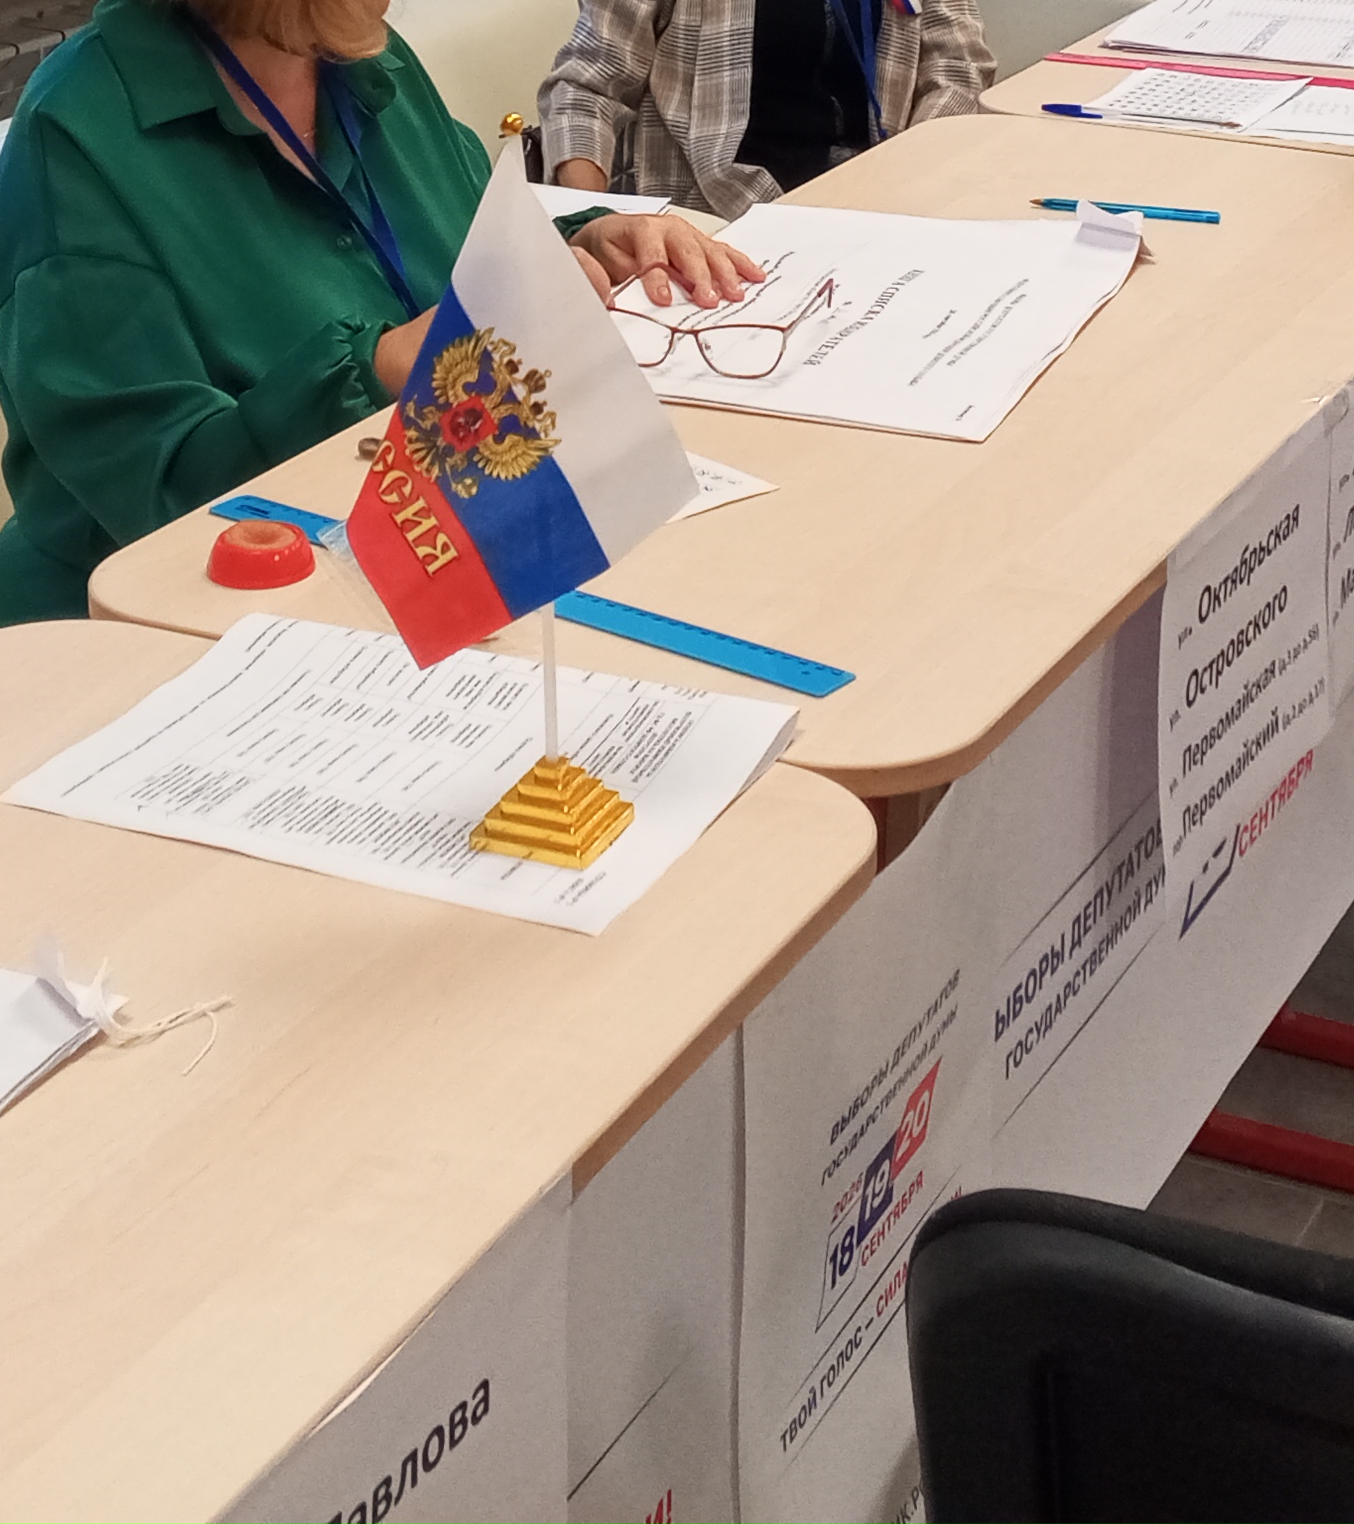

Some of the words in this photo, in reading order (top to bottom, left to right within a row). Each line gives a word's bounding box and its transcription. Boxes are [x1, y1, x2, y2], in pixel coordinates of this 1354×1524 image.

[372, 440, 460, 578] ССИЯ
[1198, 503, 1300, 624] Октябрьская
[1186, 585, 1288, 708] Островского
[1182, 707, 1280, 838] Первомайский
[1183, 659, 1276, 777] Первомайская
[1239, 749, 1314, 858] СЕНТЯБРЯ
[995, 931, 1065, 1042] ЫБОРЫ
[1005, 889, 1142, 1080] ГОСУДАРСТВЕННОЙ
[821, 1040, 928, 1187] ГОСУДАРСТВЕННОЙ
[929, 1003, 958, 1056] ДУМЫ
[830, 1057, 890, 1146] ВЫБОРЫ
[889, 968, 960, 1076] ДЕПУТАТОВ
[829, 1225, 855, 1290] 18
[862, 1158, 890, 1222] 19
[895, 1089, 931, 1162] 20
[831, 1171, 864, 1224] 2026
[861, 1170, 924, 1267] СЕНТЯБРЯ
[780, 1384, 817, 1453] ТВОЙ
[819, 1327, 863, 1400] ГОЛОС
[876, 1260, 908, 1318] СИЛА
